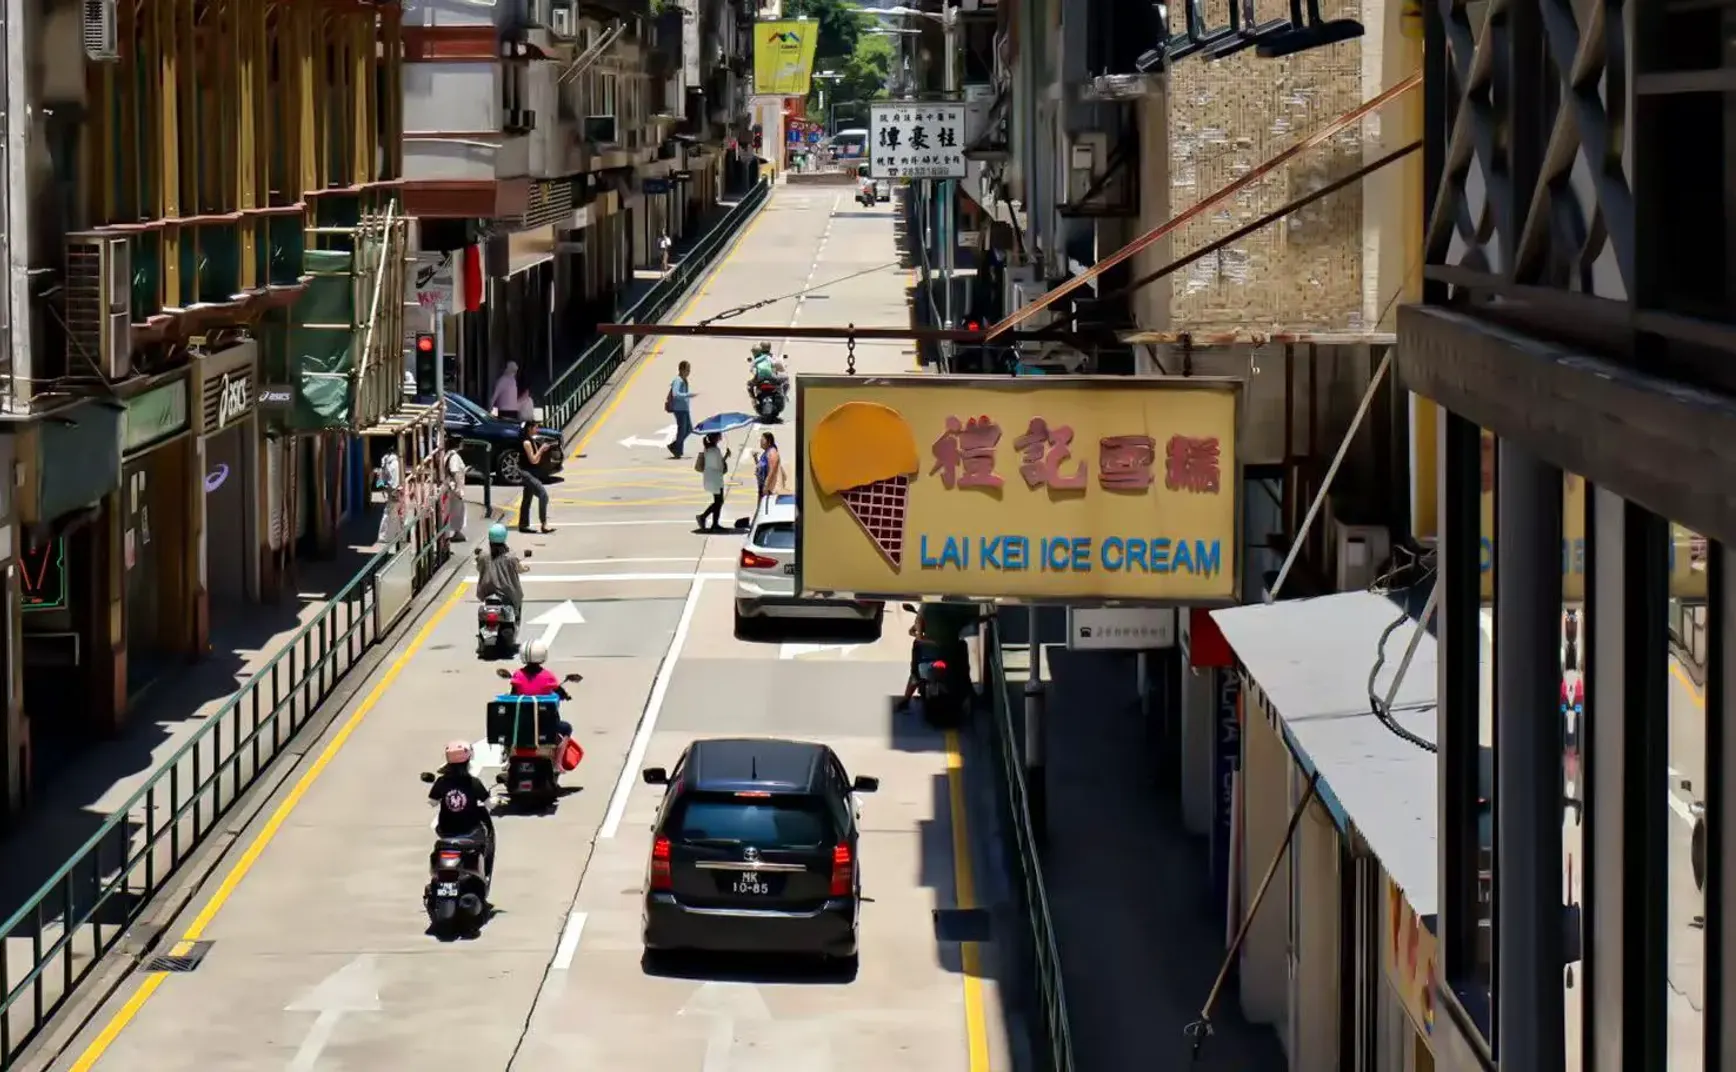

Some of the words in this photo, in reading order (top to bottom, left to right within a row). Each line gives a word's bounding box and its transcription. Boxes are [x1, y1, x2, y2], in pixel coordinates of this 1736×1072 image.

[920, 535, 969, 571] LAI
[980, 535, 1029, 572] KEI
[1040, 536, 1092, 573] ICE
[1101, 536, 1221, 579] CREAM
[742, 871, 758, 883] MK
[733, 882, 768, 894] 10-85
